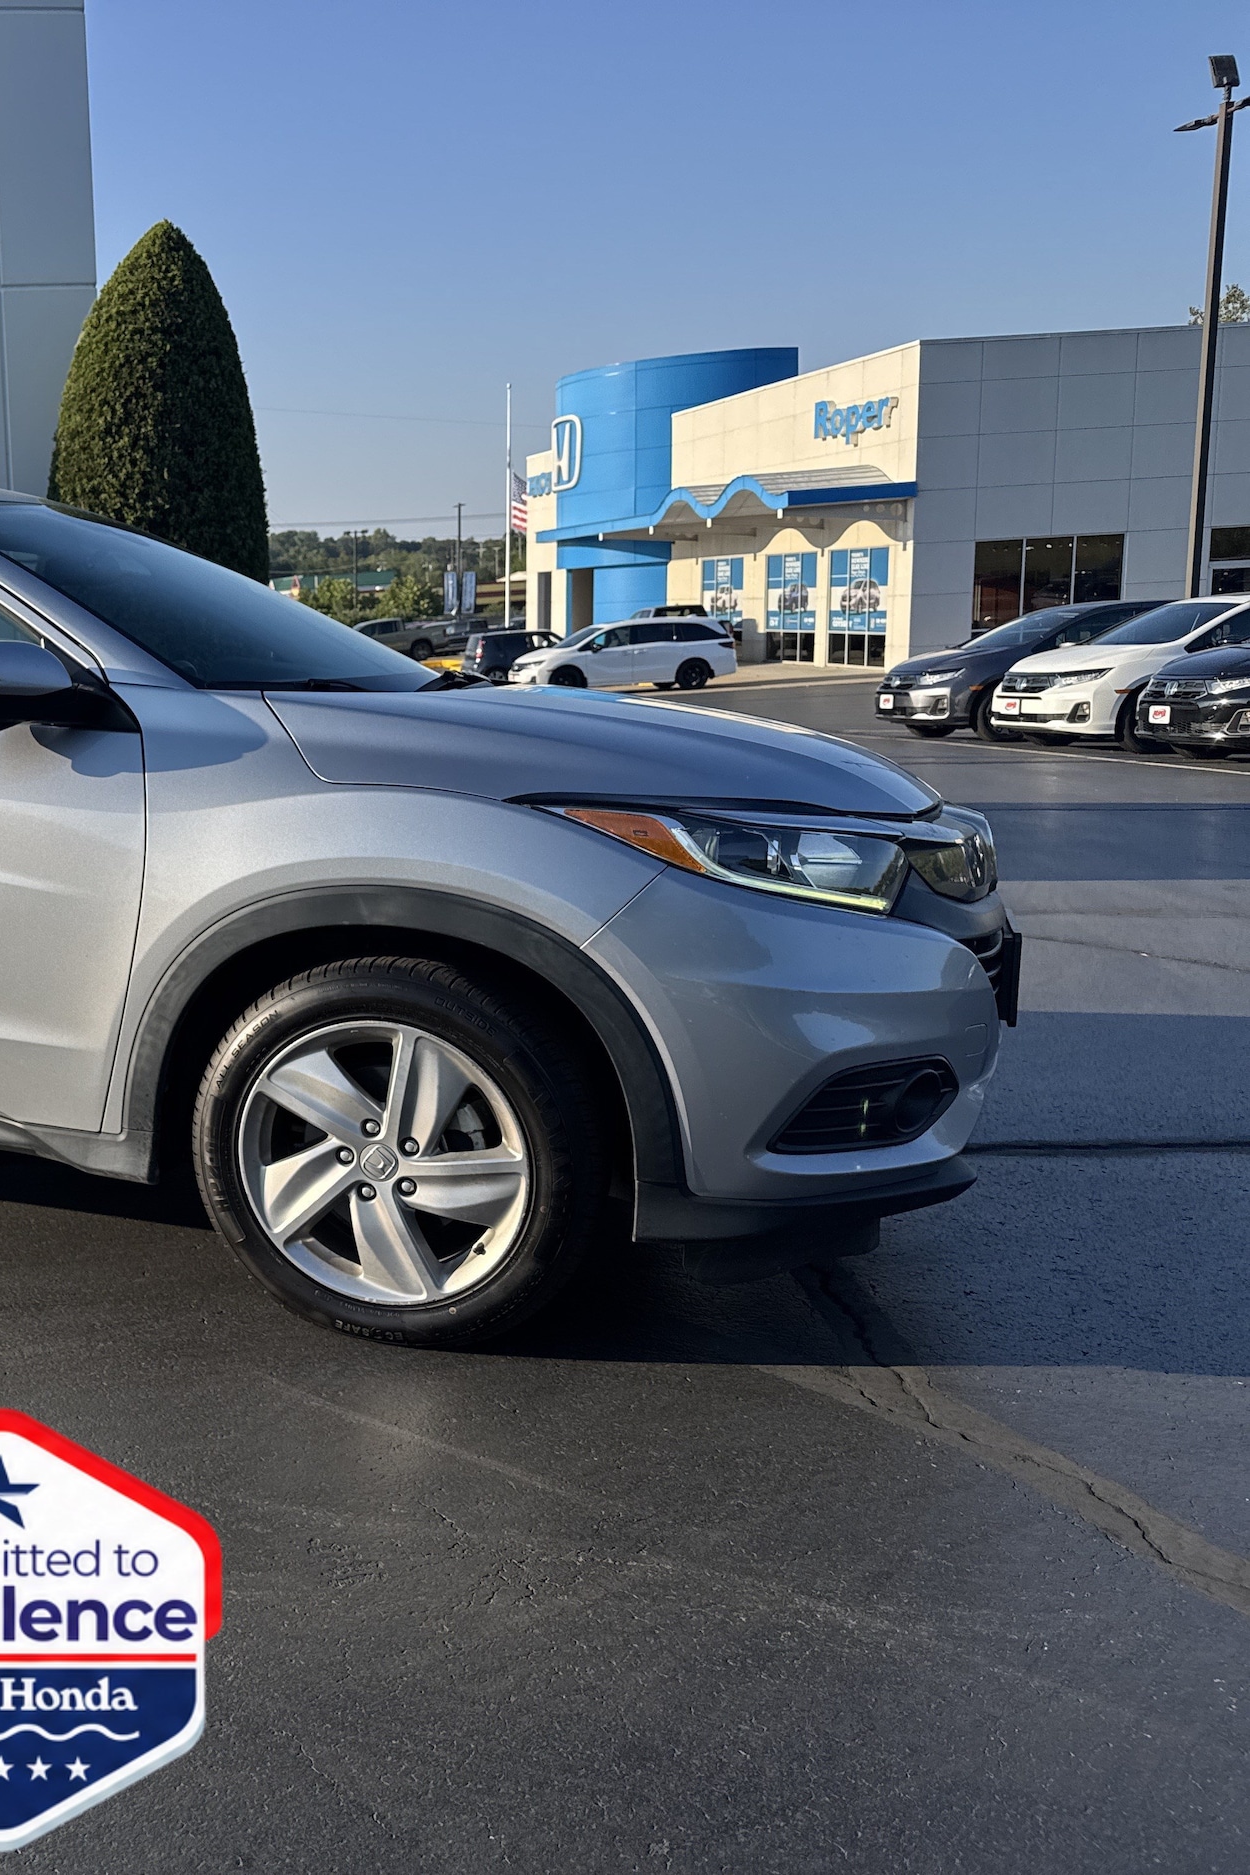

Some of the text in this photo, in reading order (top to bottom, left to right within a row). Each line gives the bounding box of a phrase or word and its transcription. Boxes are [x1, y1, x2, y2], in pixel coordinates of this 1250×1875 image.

[814, 397, 890, 445] Roper
[434, 995, 499, 1038] OUTSIDE
[216, 1064, 232, 1089] ALL
[231, 1009, 281, 1058] SEASON
